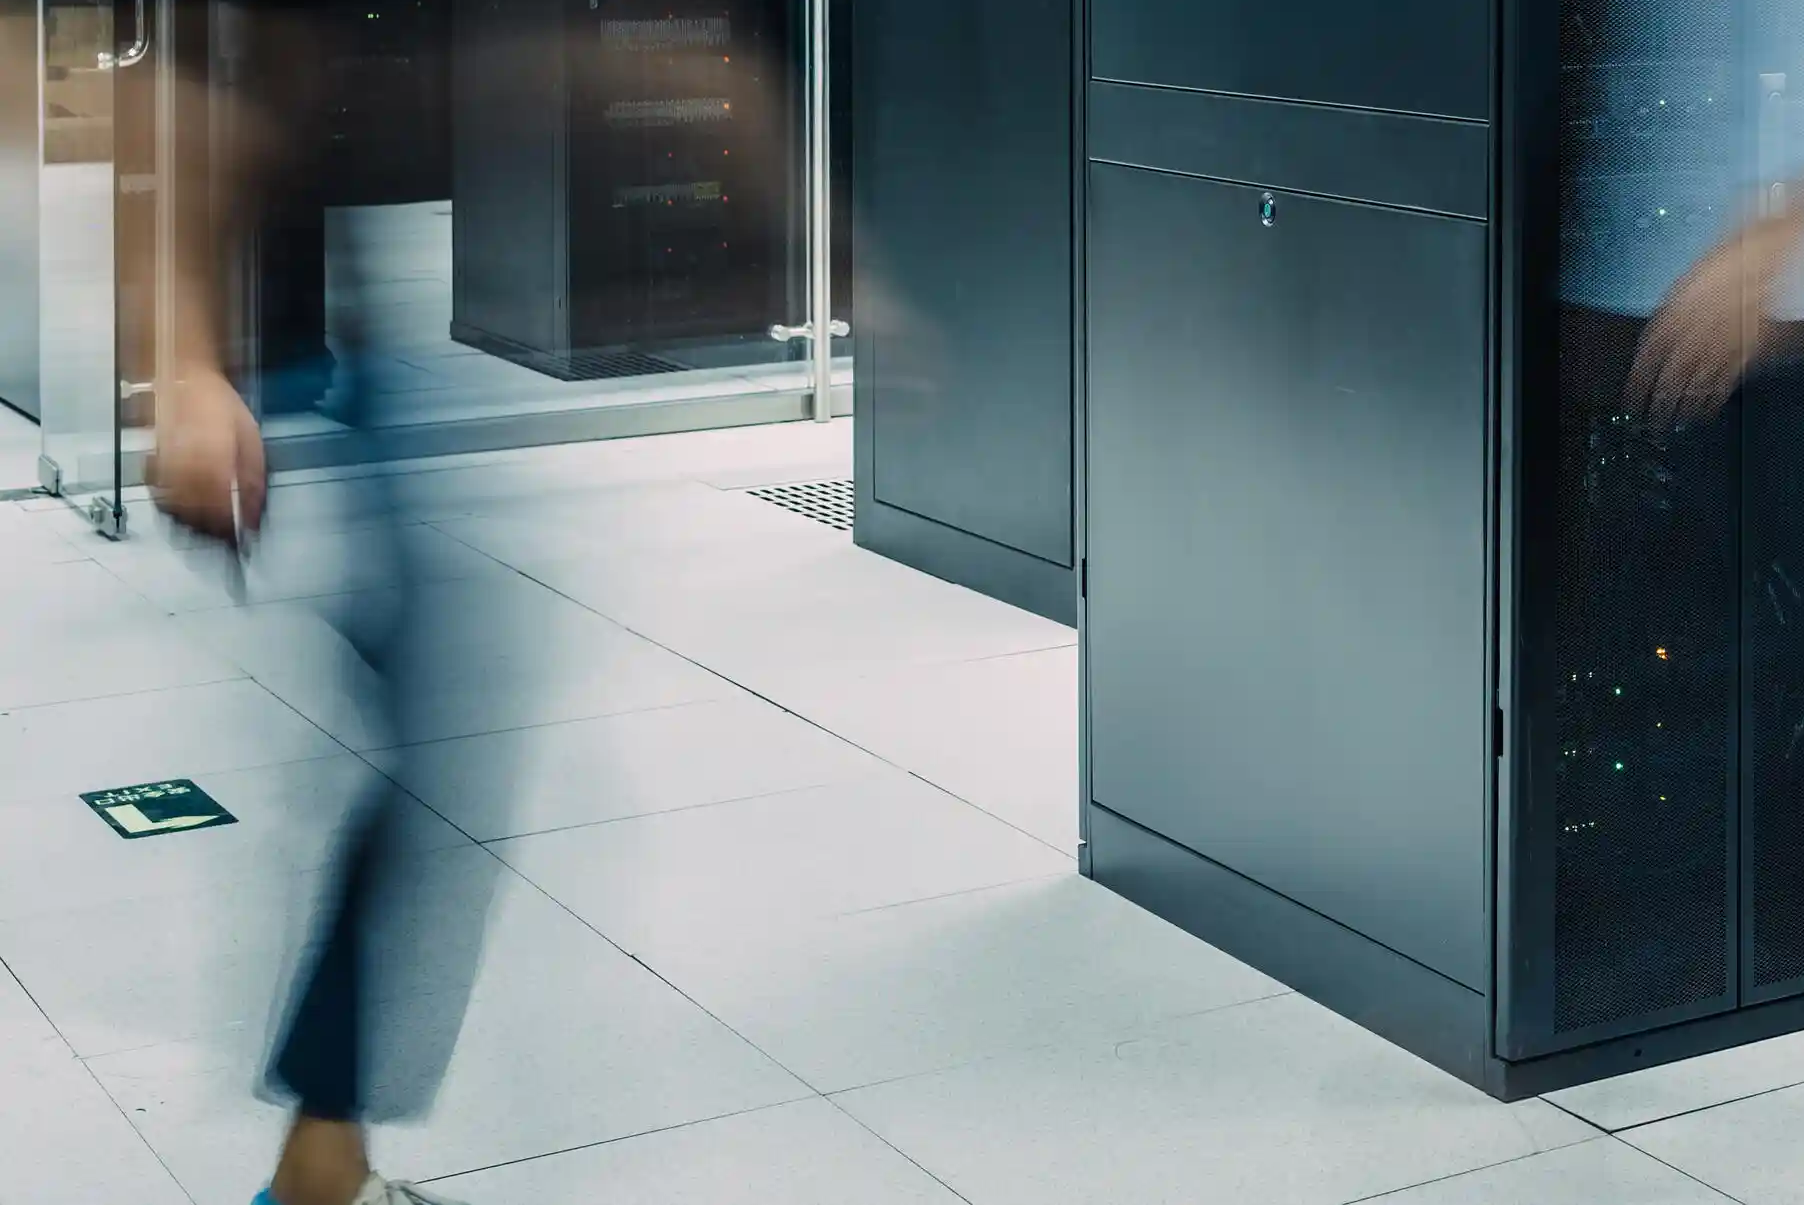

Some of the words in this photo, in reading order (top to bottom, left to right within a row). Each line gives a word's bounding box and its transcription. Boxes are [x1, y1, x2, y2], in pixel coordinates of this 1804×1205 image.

[94, 786, 191, 805] 安全出口
[104, 784, 173, 798] EXIT
